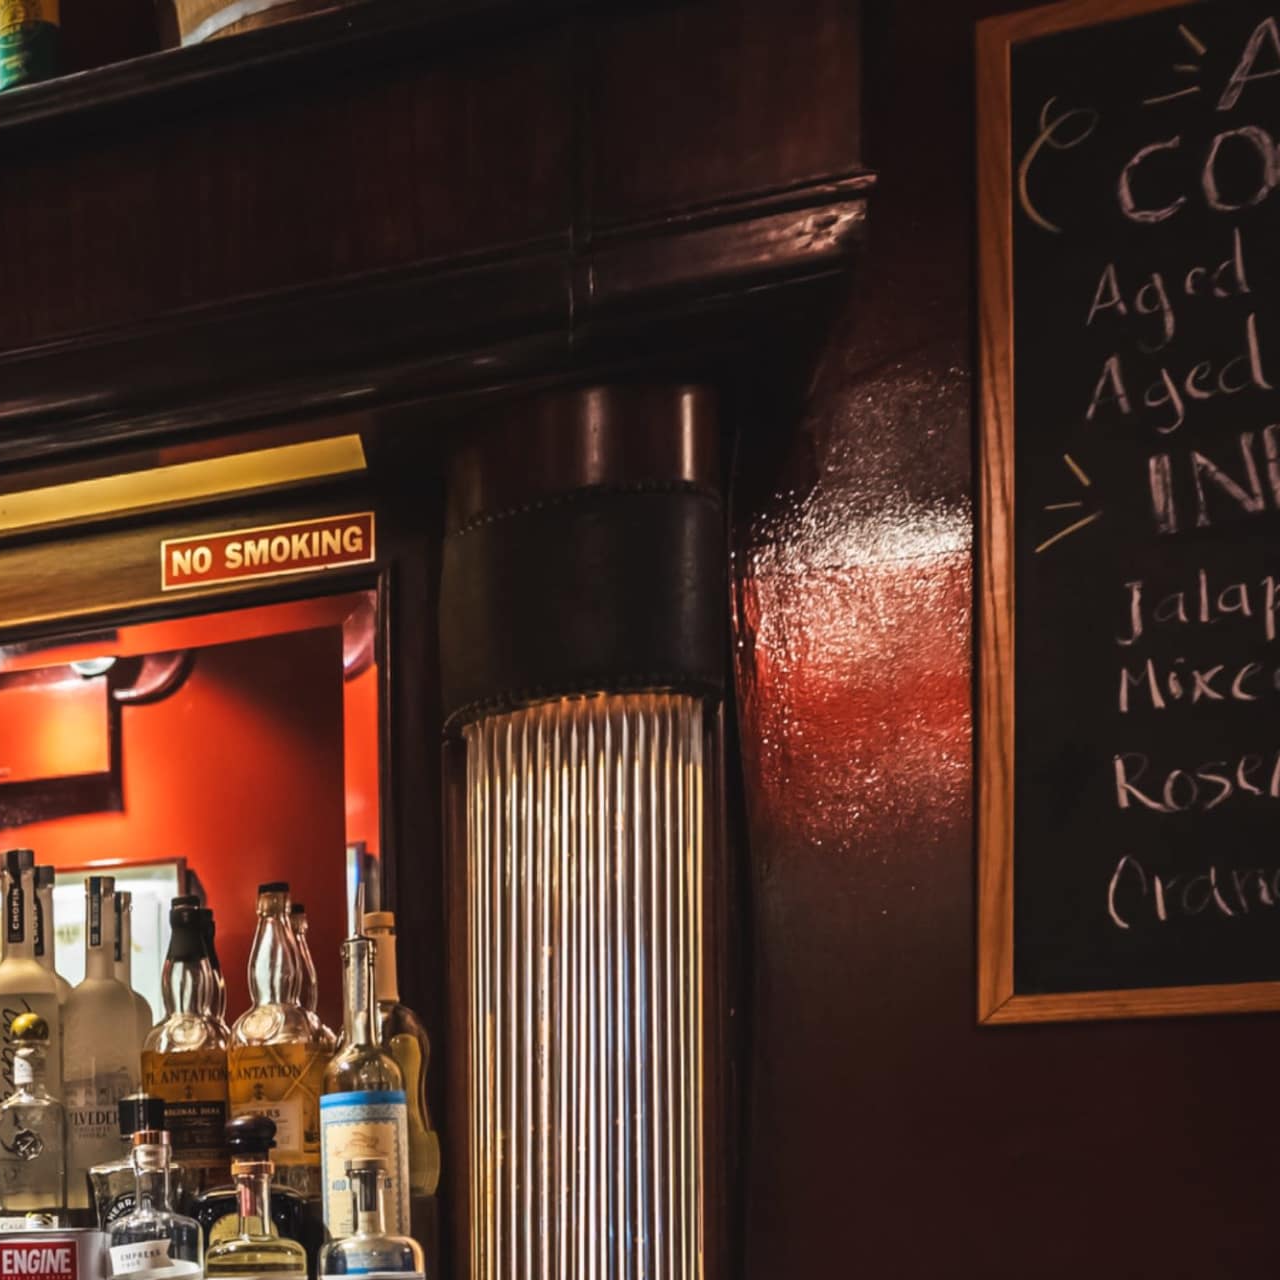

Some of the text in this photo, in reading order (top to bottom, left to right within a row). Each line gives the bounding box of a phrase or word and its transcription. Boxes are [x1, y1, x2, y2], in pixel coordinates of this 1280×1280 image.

[1118, 125, 1280, 223] CO
[1086, 227, 1252, 352] Aged
[1085, 312, 1273, 434] Aged
[171, 526, 364, 577] NO SMOKING
[1118, 657, 1280, 713] Mixe
[1113, 751, 1280, 813] Rose
[1, 1247, 73, 1275] ENGINE
